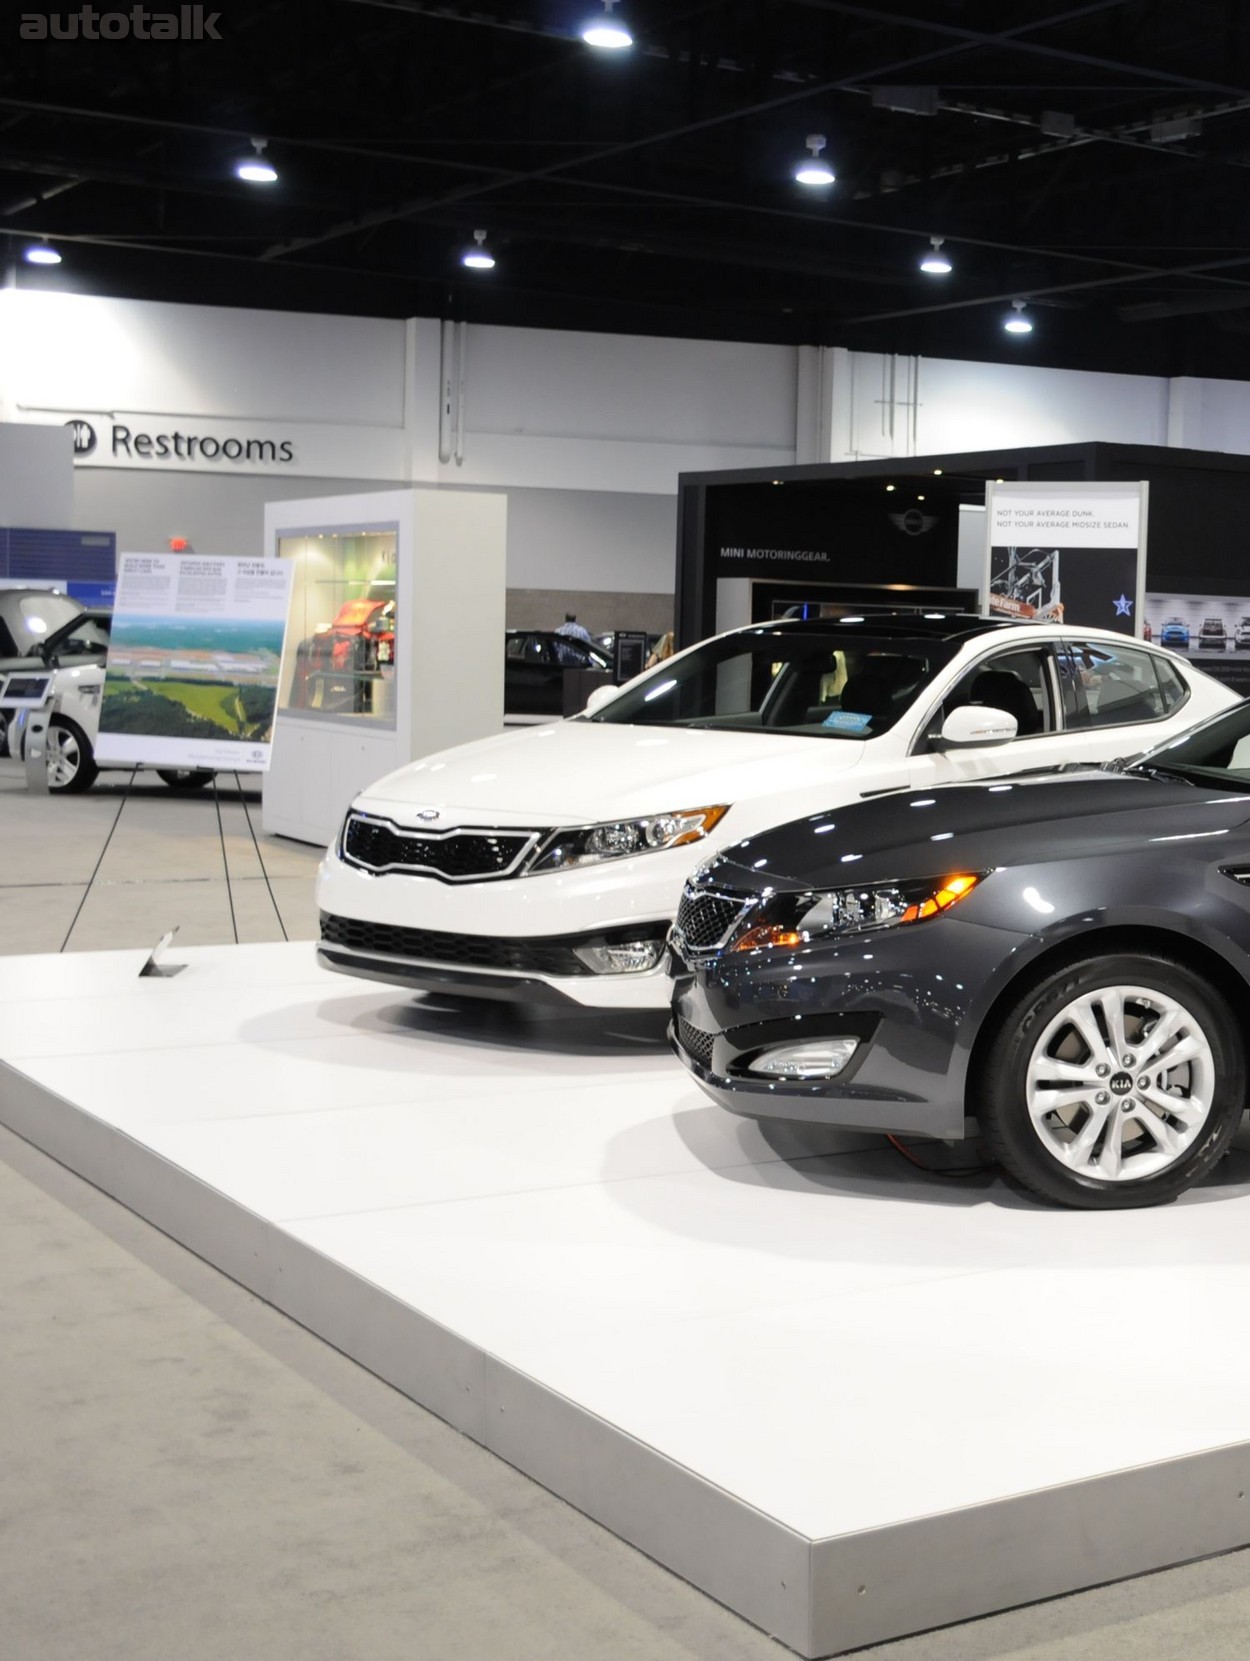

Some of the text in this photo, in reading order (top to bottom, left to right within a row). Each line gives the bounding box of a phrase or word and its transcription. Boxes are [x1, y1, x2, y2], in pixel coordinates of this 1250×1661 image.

[112, 425, 294, 462] Restrooms
[997, 510, 1012, 518] NOT
[1015, 510, 1035, 518] YOUR
[1036, 510, 1070, 518] AVERAGE
[997, 521, 1012, 529] NOT
[1014, 521, 1034, 529] YOUR
[1036, 521, 1070, 529] AVERAGE
[1072, 521, 1101, 529] MIDSIZE
[720, 547, 831, 562] MINI MOTORINGGEAR.
[1111, 1079, 1132, 1089] KIA
